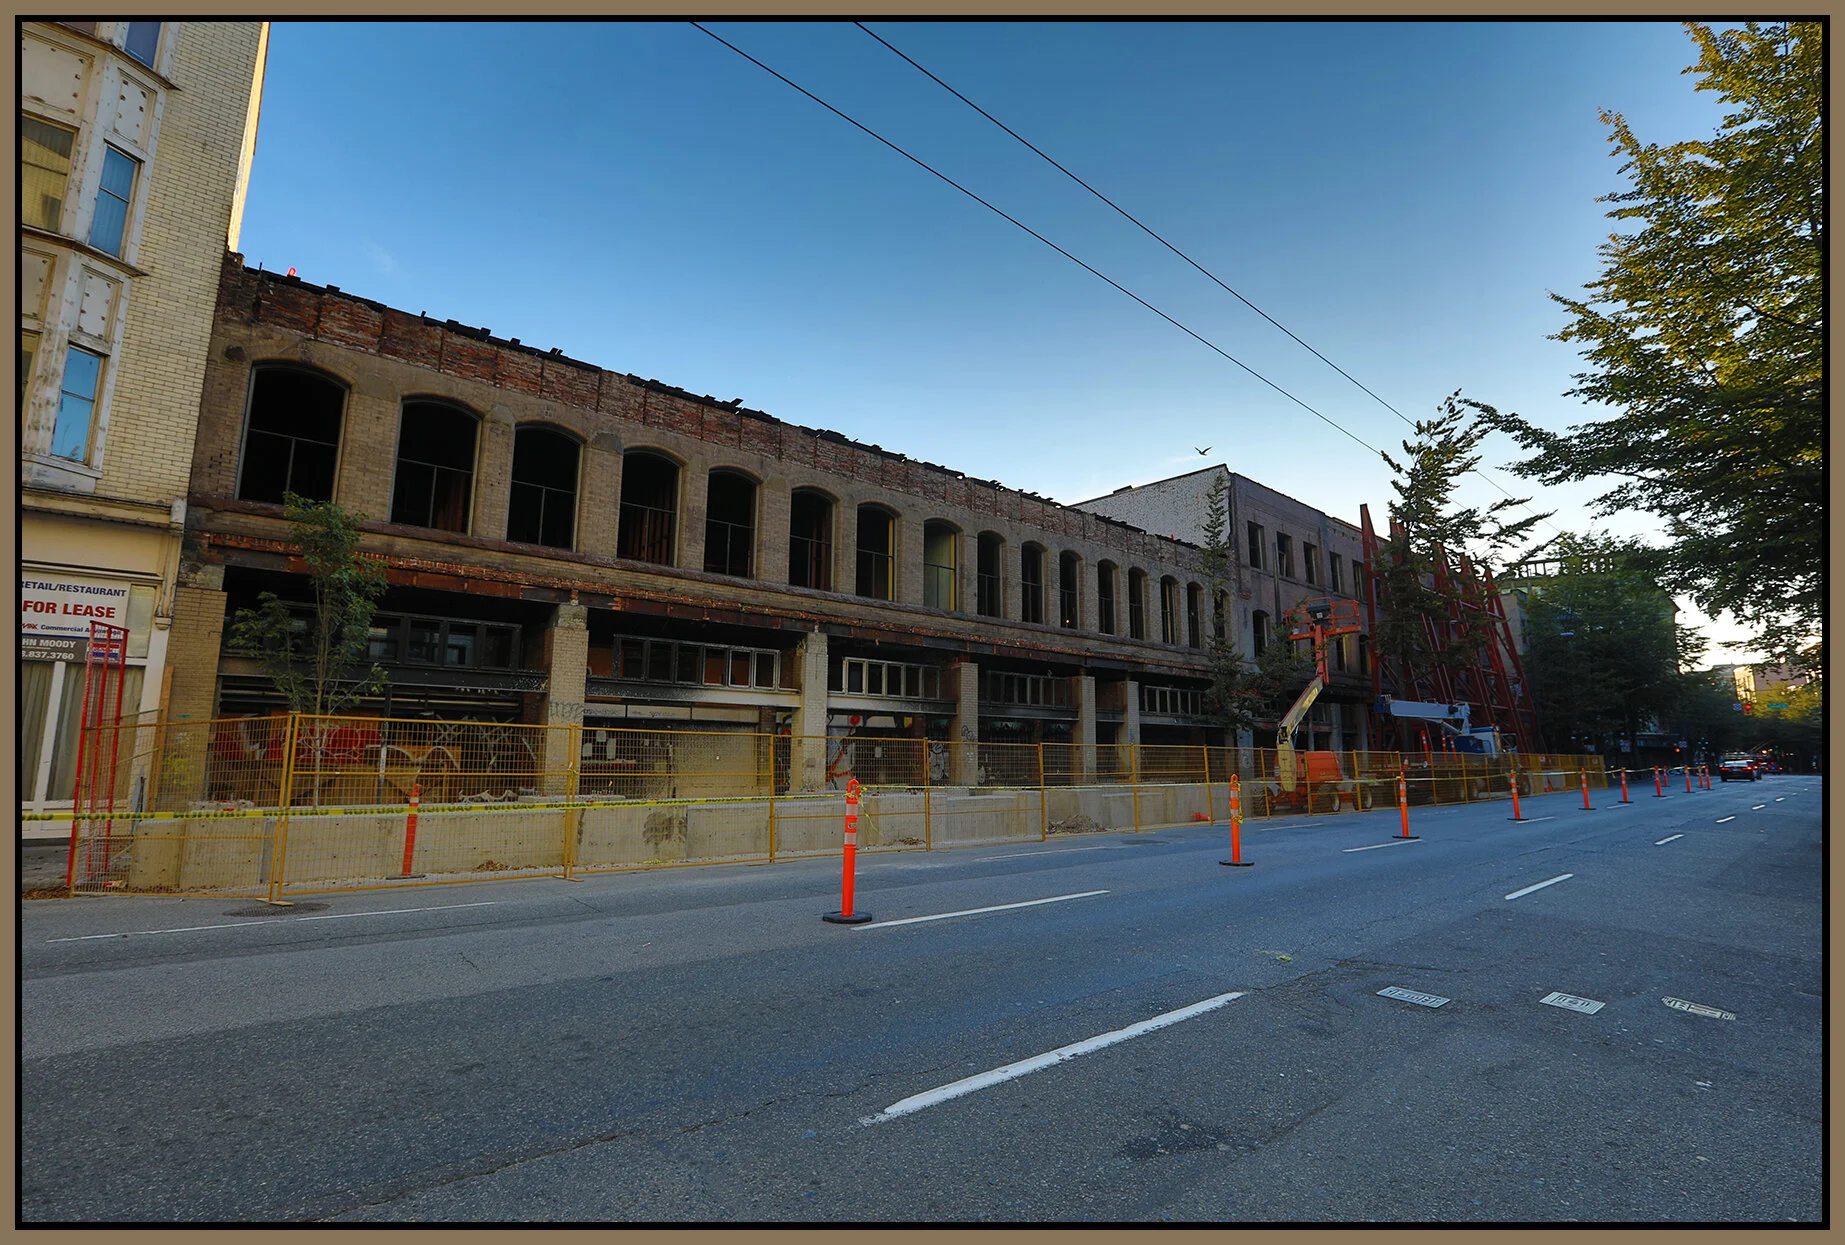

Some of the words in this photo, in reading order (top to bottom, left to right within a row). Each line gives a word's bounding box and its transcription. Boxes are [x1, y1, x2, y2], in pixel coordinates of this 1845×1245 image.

[22, 600, 57, 614] FOR
[62, 603, 116, 618] LEASE
[40, 624, 83, 633] Commercial
[40, 639, 76, 648] MOODY
